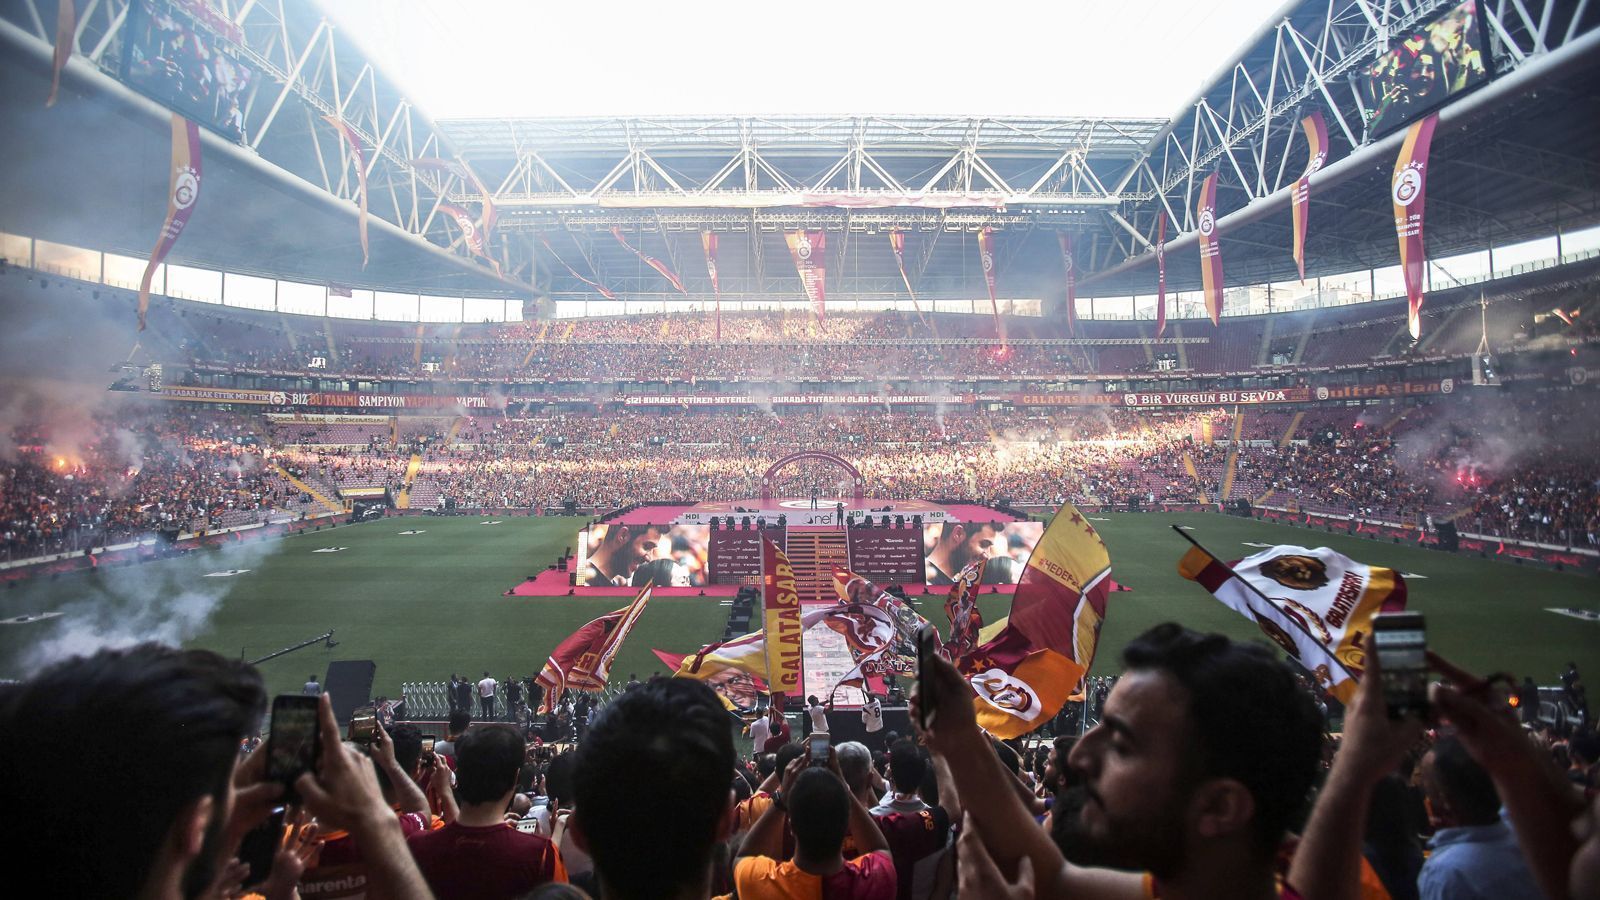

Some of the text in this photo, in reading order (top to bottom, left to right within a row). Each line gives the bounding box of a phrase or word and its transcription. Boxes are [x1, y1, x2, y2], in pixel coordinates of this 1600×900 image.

[1166, 393, 1216, 404] VURGUN
[1219, 393, 1237, 403] BU
[1241, 390, 1287, 402] SEVDA
[814, 512, 833, 524] nef
[848, 510, 864, 518] HDI
[1325, 570, 1364, 629] GALATASARAY
[874, 707, 880, 718] 8
